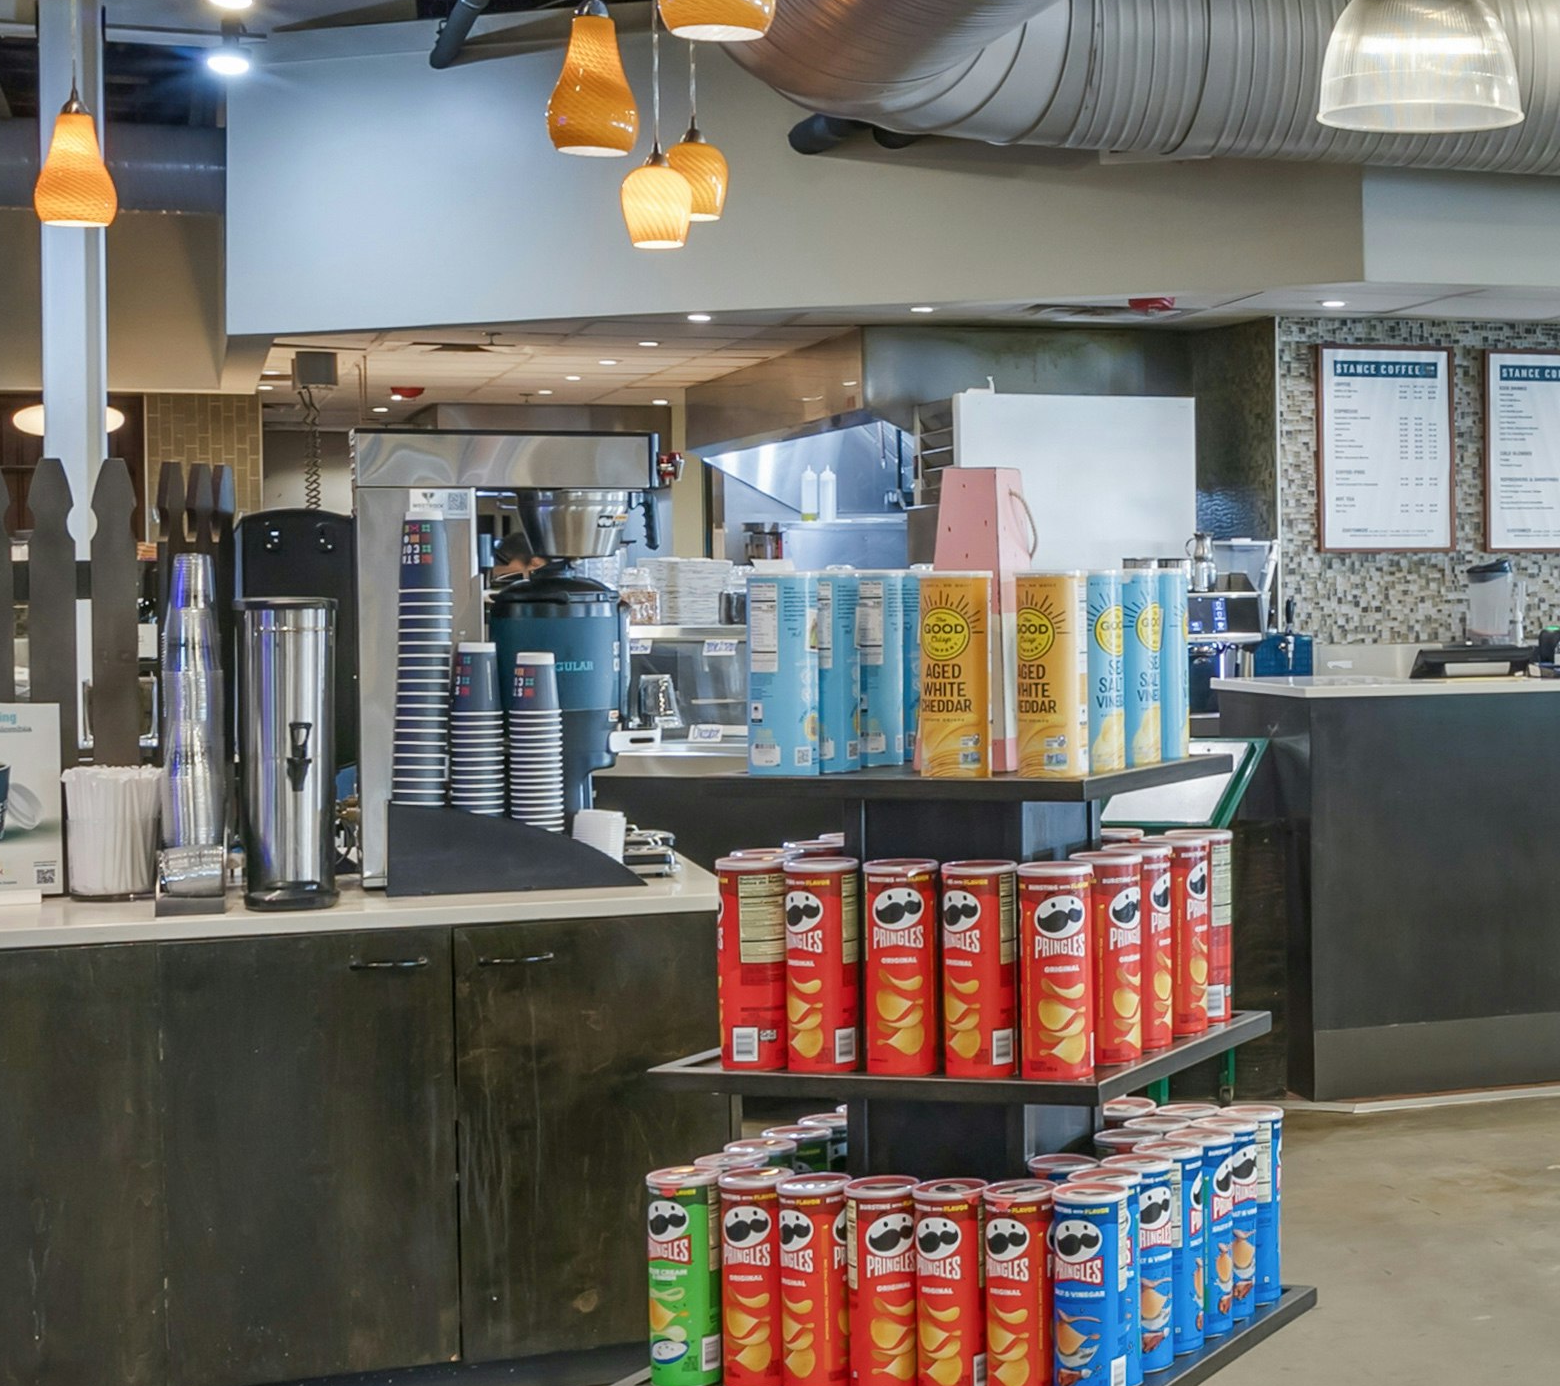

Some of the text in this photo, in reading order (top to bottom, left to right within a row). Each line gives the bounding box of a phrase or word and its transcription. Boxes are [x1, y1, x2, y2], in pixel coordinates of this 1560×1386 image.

[1336, 364, 1420, 375] STANCE COFFEE
[1502, 367, 1540, 378] STANCE
[924, 623, 964, 634] GOOD
[555, 661, 593, 671] GULAR
[926, 663, 961, 679] AGED
[924, 682, 966, 697] WHITE
[922, 699, 972, 713] CHEDDAR
[873, 925, 924, 949] PRINGLES
[1035, 933, 1085, 959] PRINGLES
[1044, 964, 1080, 973] ORIGINAL
[876, 1281, 911, 1293] ORIGINAL
[1070, 1290, 1105, 1298] VINEGAR
